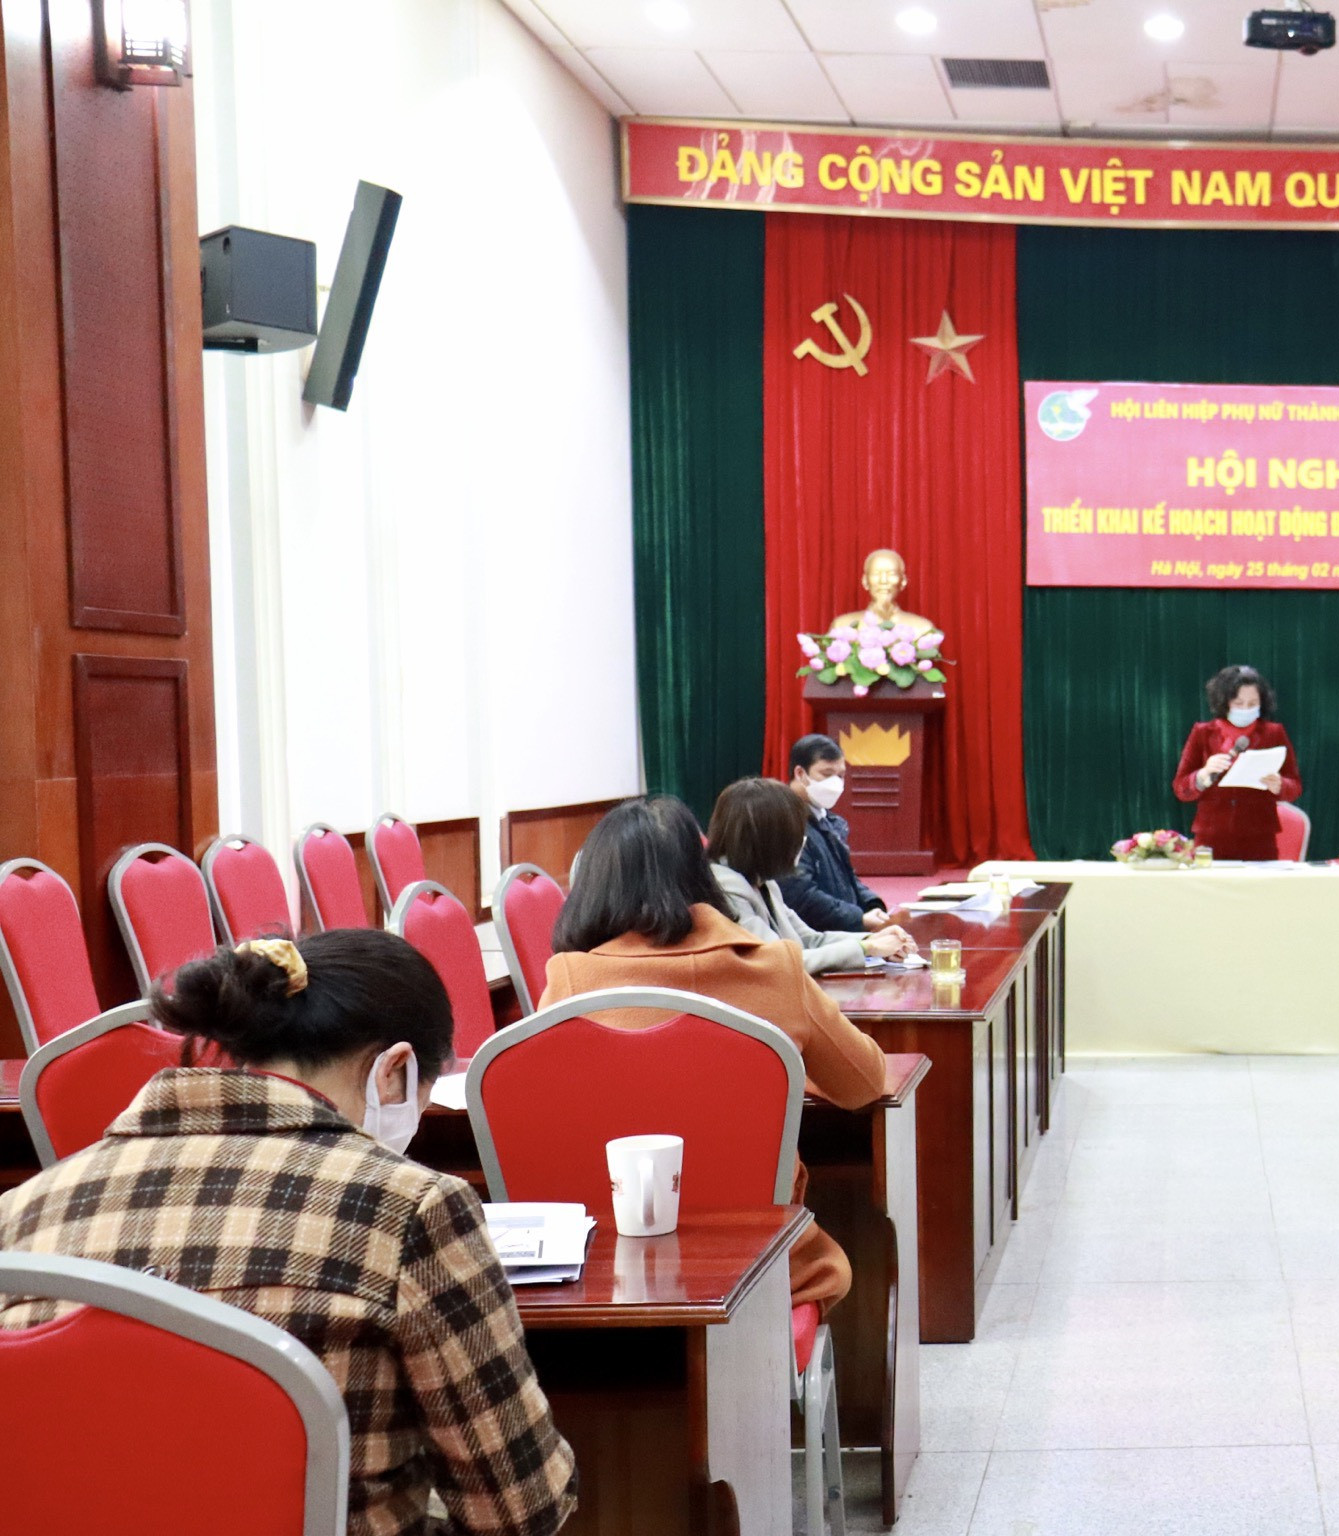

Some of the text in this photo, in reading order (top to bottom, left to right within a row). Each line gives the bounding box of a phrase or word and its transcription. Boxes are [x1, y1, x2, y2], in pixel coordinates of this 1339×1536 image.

[676, 133, 805, 189] ĐẢNG
[818, 145, 943, 203] CỘNG
[954, 149, 1045, 201] SẢN
[1060, 157, 1153, 215] VIỆT
[1172, 169, 1273, 206] NAM
[1110, 398, 1142, 422] HỘI
[1144, 399, 1179, 419] LIÊN
[1182, 399, 1219, 423] HIỆP
[1221, 403, 1256, 424] PHỤ
[1258, 401, 1285, 421] NỮ
[1186, 449, 1257, 496] HỘI
[1097, 508, 1139, 535] KHAI
[1142, 501, 1167, 535] KẾ
[1169, 509, 1229, 541] HOẠCH
[1231, 509, 1277, 542] HOẠT
[1279, 504, 1328, 542] ĐỘNG
[1151, 561, 1172, 576] Hà
[1207, 562, 1244, 580] ngày
[1246, 561, 1265, 577] 25
[1267, 562, 1309, 581] tháng
[1311, 562, 1331, 578] 02
